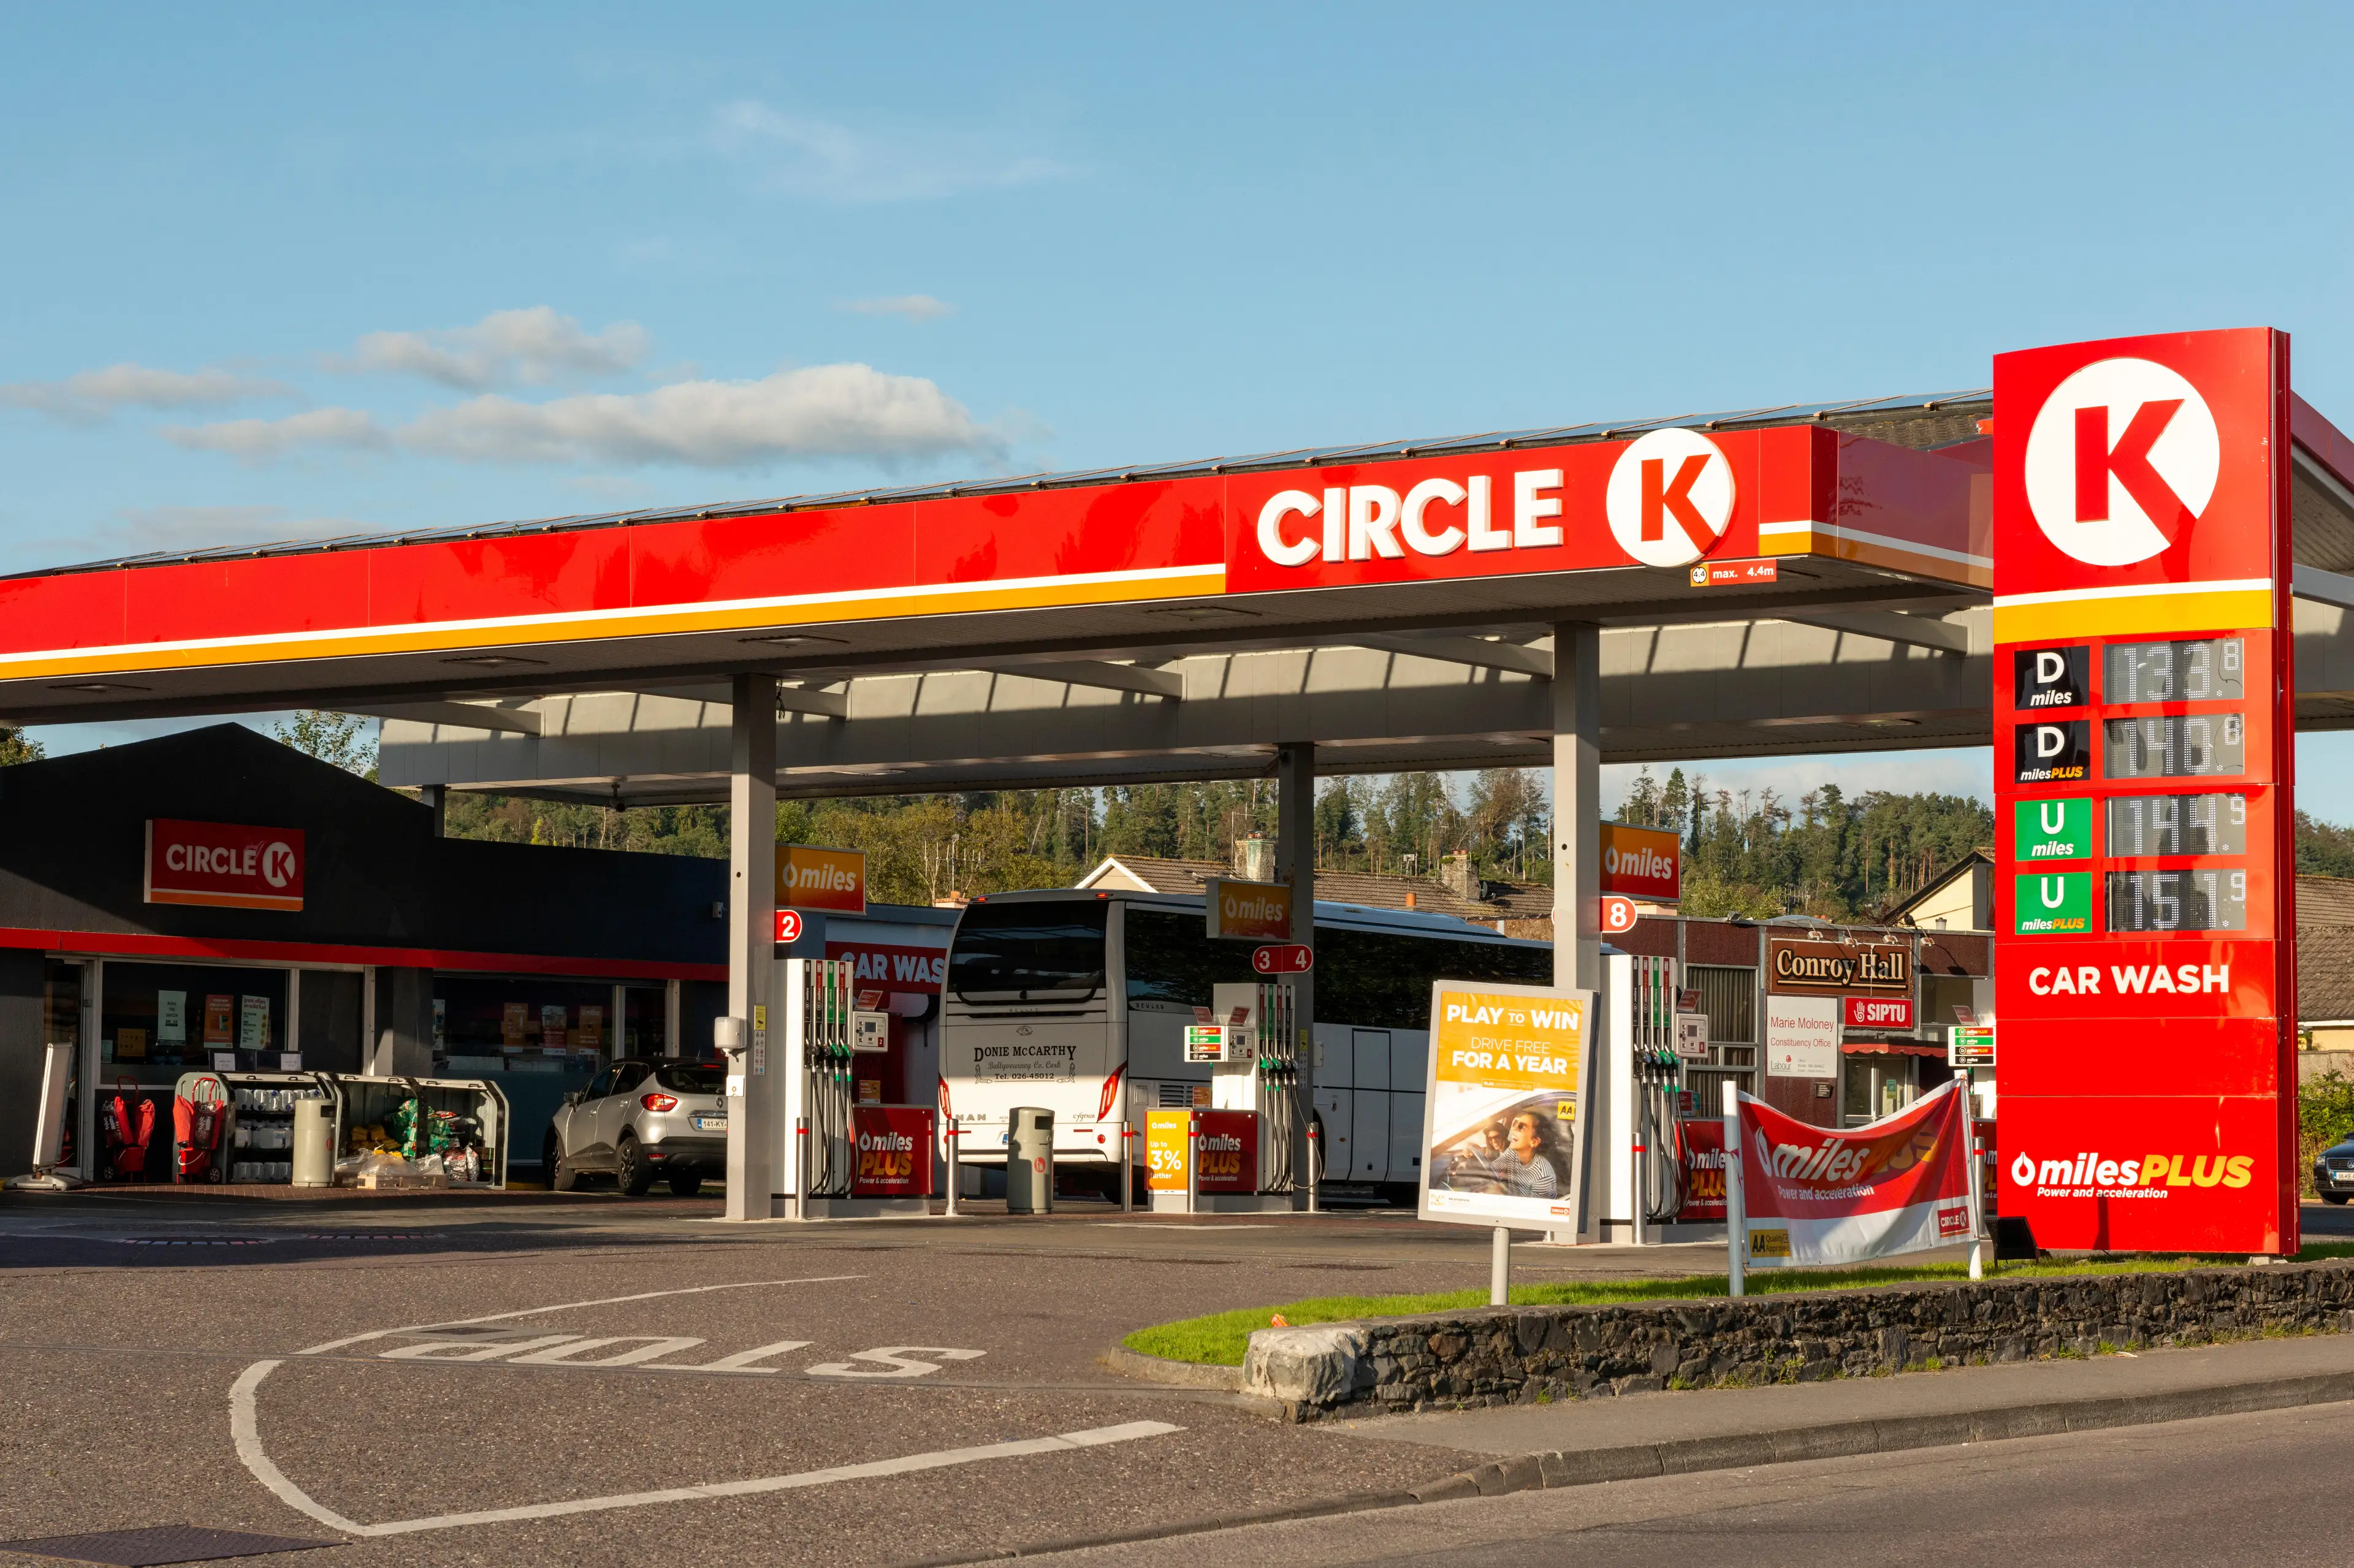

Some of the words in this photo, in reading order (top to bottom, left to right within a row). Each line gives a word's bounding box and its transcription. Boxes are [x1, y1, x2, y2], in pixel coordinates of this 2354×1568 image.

[2072, 397, 2200, 547] K
[1257, 468, 1564, 566] CIRCLE
[1638, 452, 1724, 561] K
[1713, 570, 1738, 579] max.
[1747, 566, 1773, 576] 4.4m
[2036, 651, 2065, 683] D
[2029, 689, 2073, 706] miles
[2037, 726, 2065, 758] D
[2021, 766, 2084, 781] milesPLUS
[2040, 802, 2064, 834] U
[2030, 840, 2074, 857] miles
[166, 843, 256, 876] CIRCLE
[271, 850, 294, 884] K
[1620, 847, 1673, 880] miles
[799, 863, 856, 892] miles
[2040, 875, 2064, 908] U
[1238, 896, 1284, 922] miles
[1610, 902, 1627, 927] 8
[782, 915, 795, 937] 2
[2021, 917, 2085, 931] milesPLUS
[1259, 950, 1270, 970] 3
[1295, 950, 1307, 969] 4
[1777, 949, 1856, 985] Conroy
[1859, 953, 1905, 980] Hall
[2028, 965, 2100, 995] CAR
[2110, 964, 2230, 994] WASH
[1446, 1004, 1504, 1025] PLAY
[1508, 1013, 1525, 1024] TO
[1530, 1009, 1579, 1030] WIN
[1867, 1003, 1906, 1022] SIPTU
[1770, 1016, 1796, 1029] Marie
[1797, 1017, 1834, 1032] Moloney
[1471, 1037, 1512, 1052] DRIVE
[1515, 1040, 1551, 1054] FREE
[1770, 1037, 1811, 1049] Constituency
[1813, 1038, 1831, 1048] Office
[973, 1046, 1010, 1062] DONIE
[1012, 1045, 1077, 1060] McCARTHY
[1452, 1050, 1493, 1069] FOR
[1495, 1054, 1510, 1070] A
[1514, 1054, 1567, 1075] YEAR
[988, 1060, 1032, 1071] Ballyvourney
[1034, 1060, 1044, 1069] Co.
[1045, 1060, 1061, 1069] Cork
[1770, 1060, 1791, 1070] Labour
[1073, 1111, 1095, 1122] cygnus
[1560, 1105, 1573, 1115] AA
[1157, 1121, 1177, 1130] miles
[871, 1132, 913, 1151] miles
[1208, 1133, 1241, 1151] miles
[859, 1152, 913, 1176] PLUS
[1149, 1149, 1183, 1170] 3%
[1198, 1152, 1241, 1174] PLUS
[1772, 1137, 1870, 1182] miles
[2037, 1151, 2254, 1187] milesPLUS
[1777, 1184, 1797, 1200] Power
[1798, 1186, 1813, 1200] and
[1815, 1183, 1874, 1200] acceleration
[2037, 1186, 2070, 1197] Power
[2072, 1187, 2095, 1198] and
[2097, 1187, 2168, 1199] acceleration
[1751, 1234, 1766, 1253] AA
[1766, 1233, 1783, 1244] Quality
[1766, 1243, 1790, 1254] Approved
[378, 1334, 988, 1378] STOP
